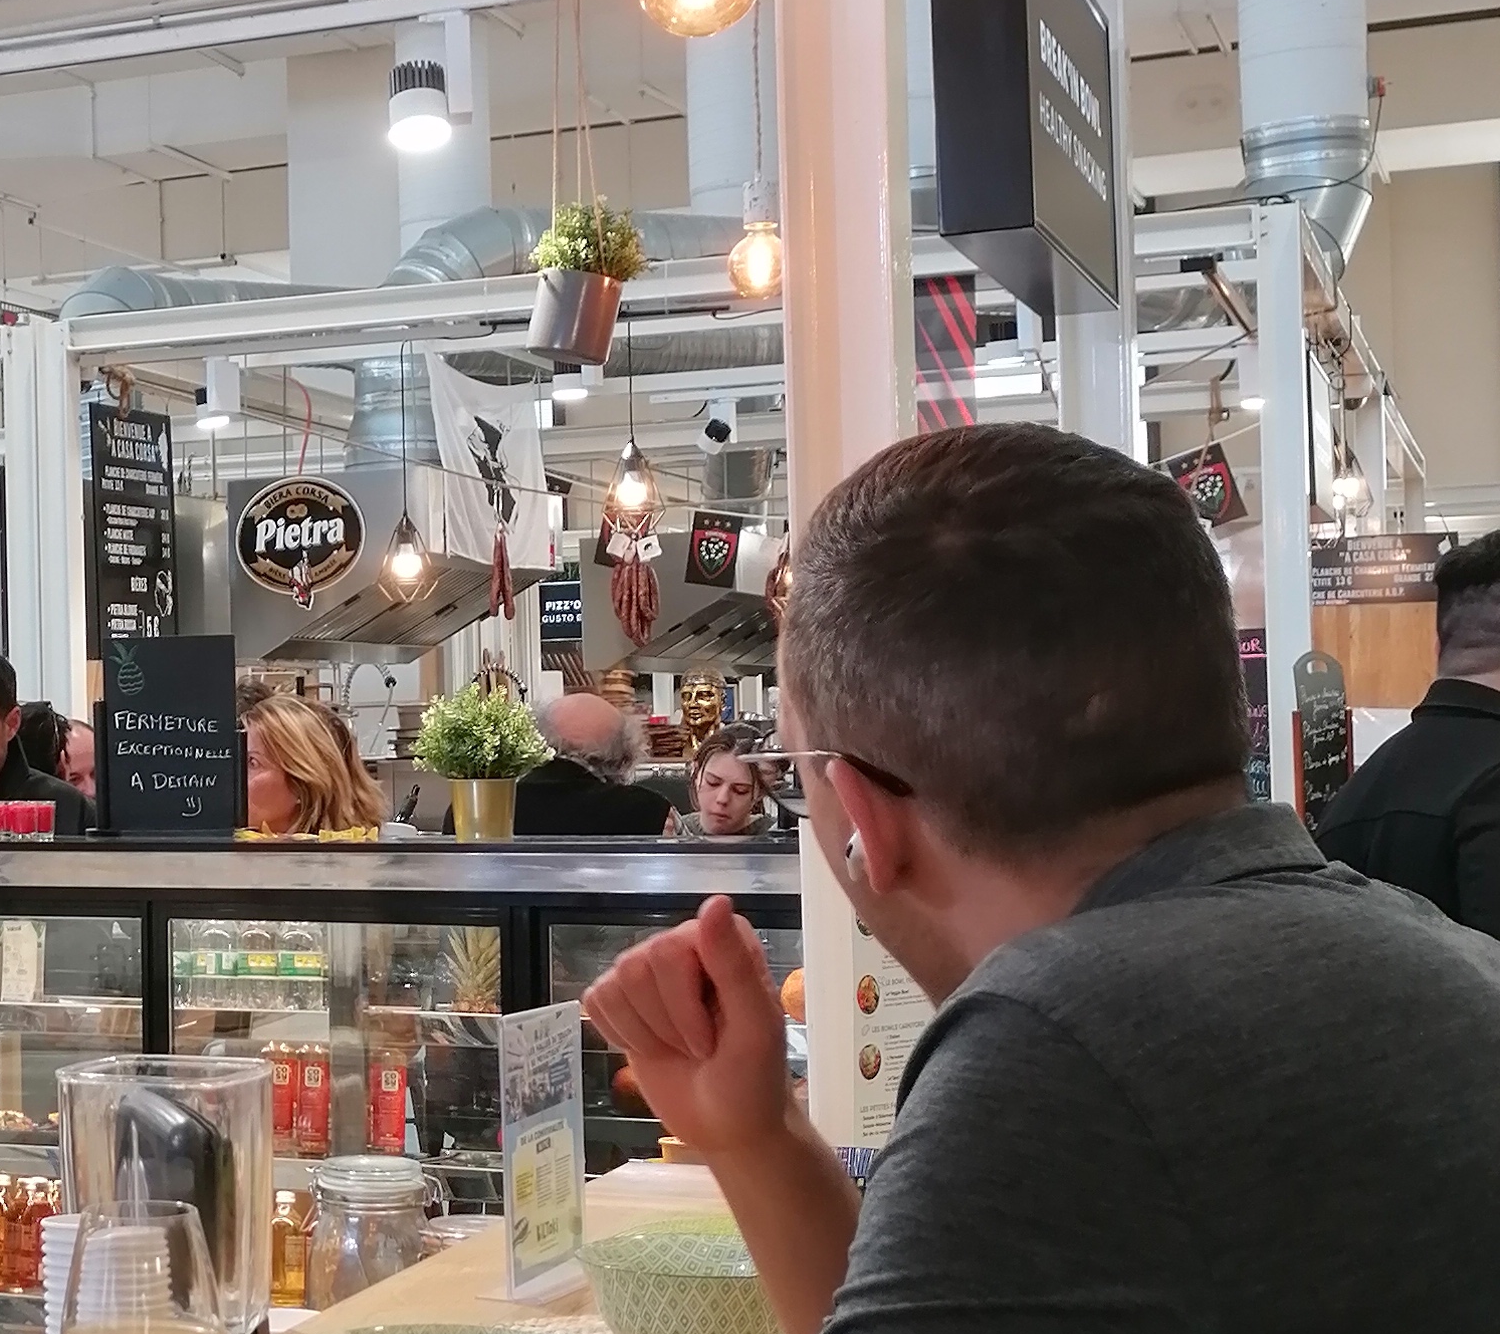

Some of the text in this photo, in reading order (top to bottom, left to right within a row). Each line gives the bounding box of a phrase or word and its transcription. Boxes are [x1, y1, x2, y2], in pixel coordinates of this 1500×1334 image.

[1039, 90, 1073, 158] HEALTHY
[254, 515, 346, 554] Pietra
[1353, 550, 1377, 562] CASA
[541, 614, 574, 624] GUSTO
[113, 710, 219, 734] FERMETURE
[116, 740, 232, 759] EXCEPTIONNELLE
[131, 771, 218, 794] A DEMAIN
